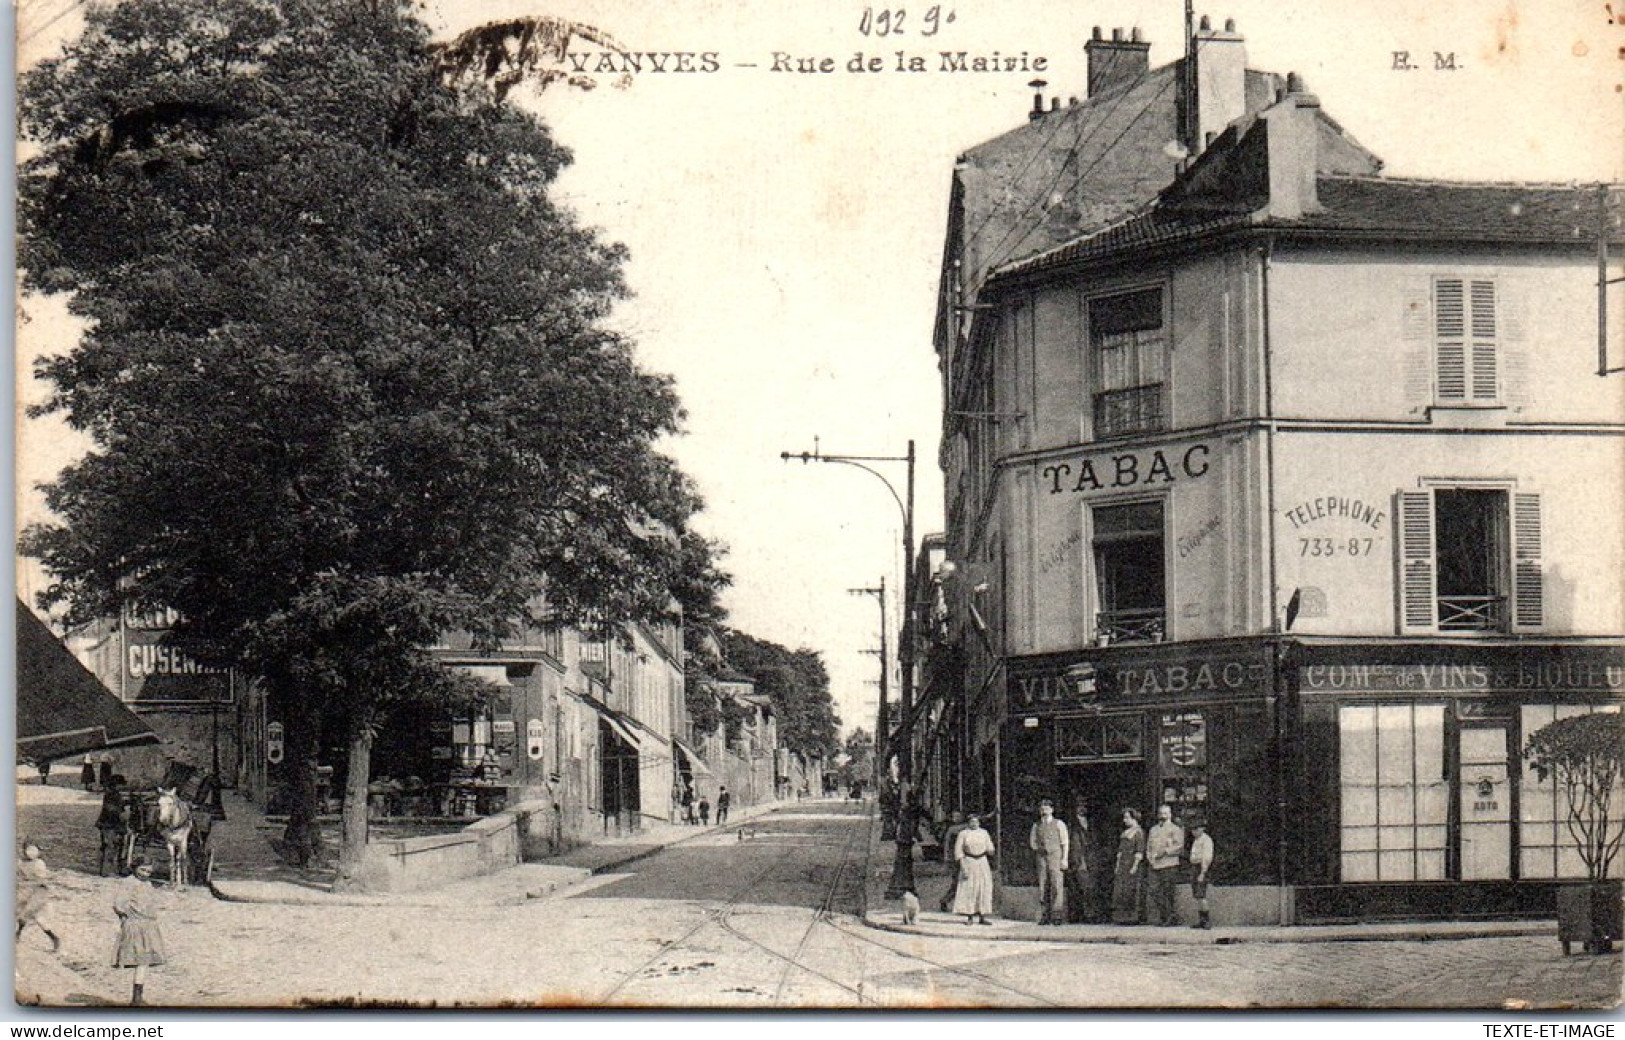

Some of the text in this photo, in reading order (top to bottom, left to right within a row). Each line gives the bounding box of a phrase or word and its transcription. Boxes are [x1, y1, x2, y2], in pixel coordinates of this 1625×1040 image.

[1043, 444, 1210, 494] TABAC
[1284, 497, 1387, 531] TELEPHONE
[1299, 537, 1373, 557] 733-87
[1115, 661, 1244, 695] TABAC
[1418, 661, 1488, 688] VINS
